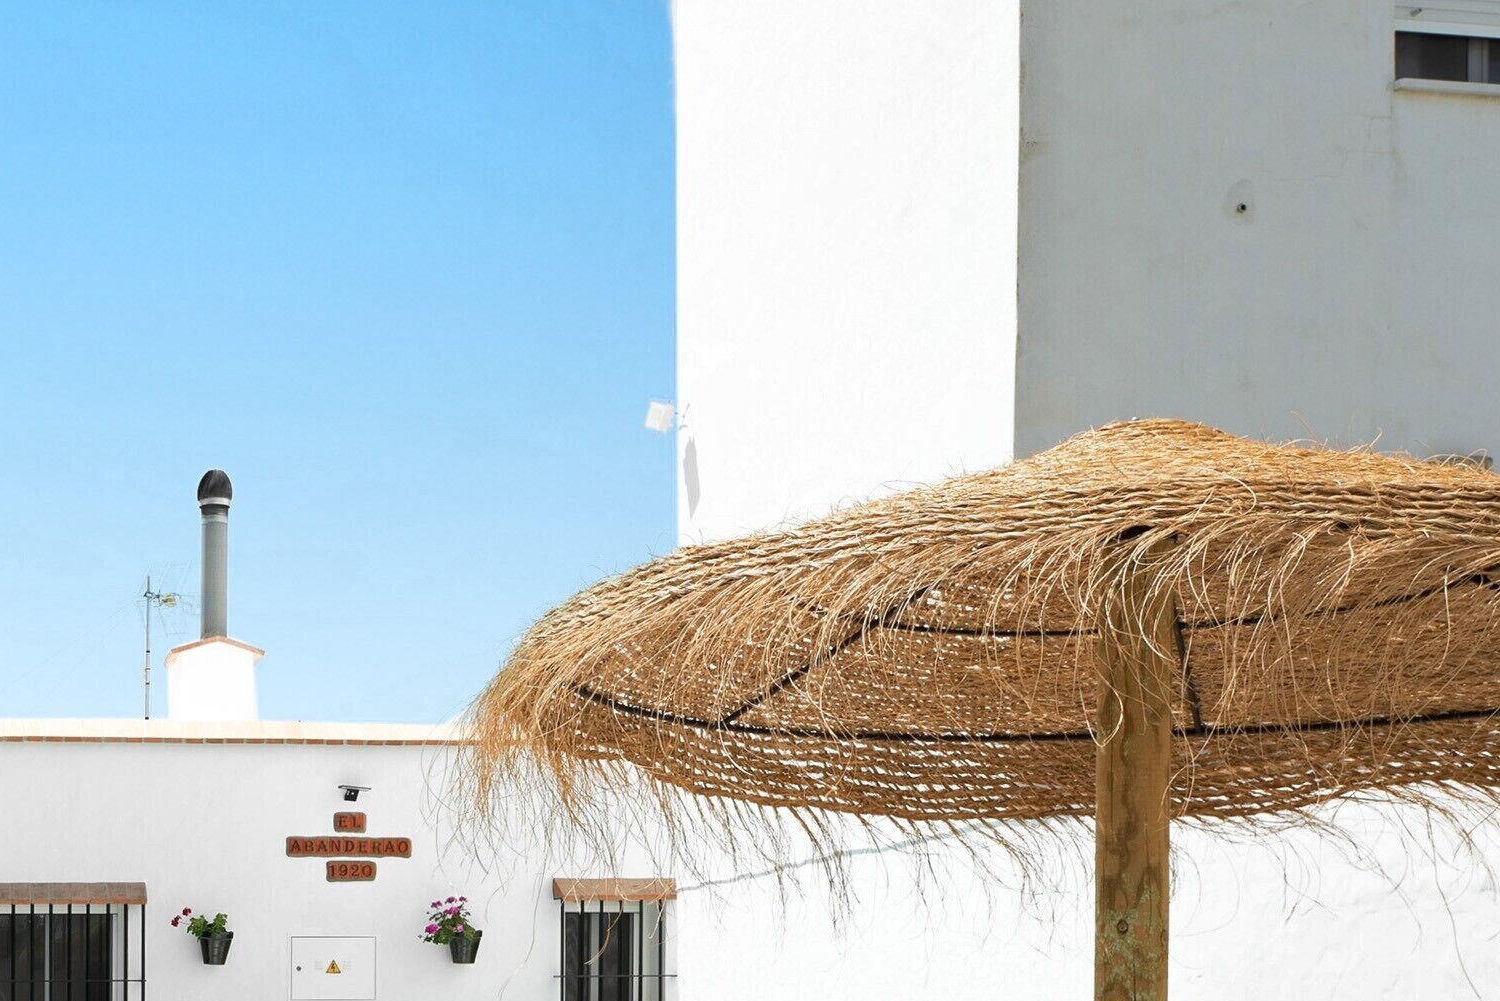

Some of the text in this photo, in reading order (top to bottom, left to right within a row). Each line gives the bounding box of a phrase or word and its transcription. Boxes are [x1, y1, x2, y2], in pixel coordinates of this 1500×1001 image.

[338, 815, 361, 828] EL
[290, 839, 409, 854] ABANDERAO
[329, 864, 373, 877] 1920
